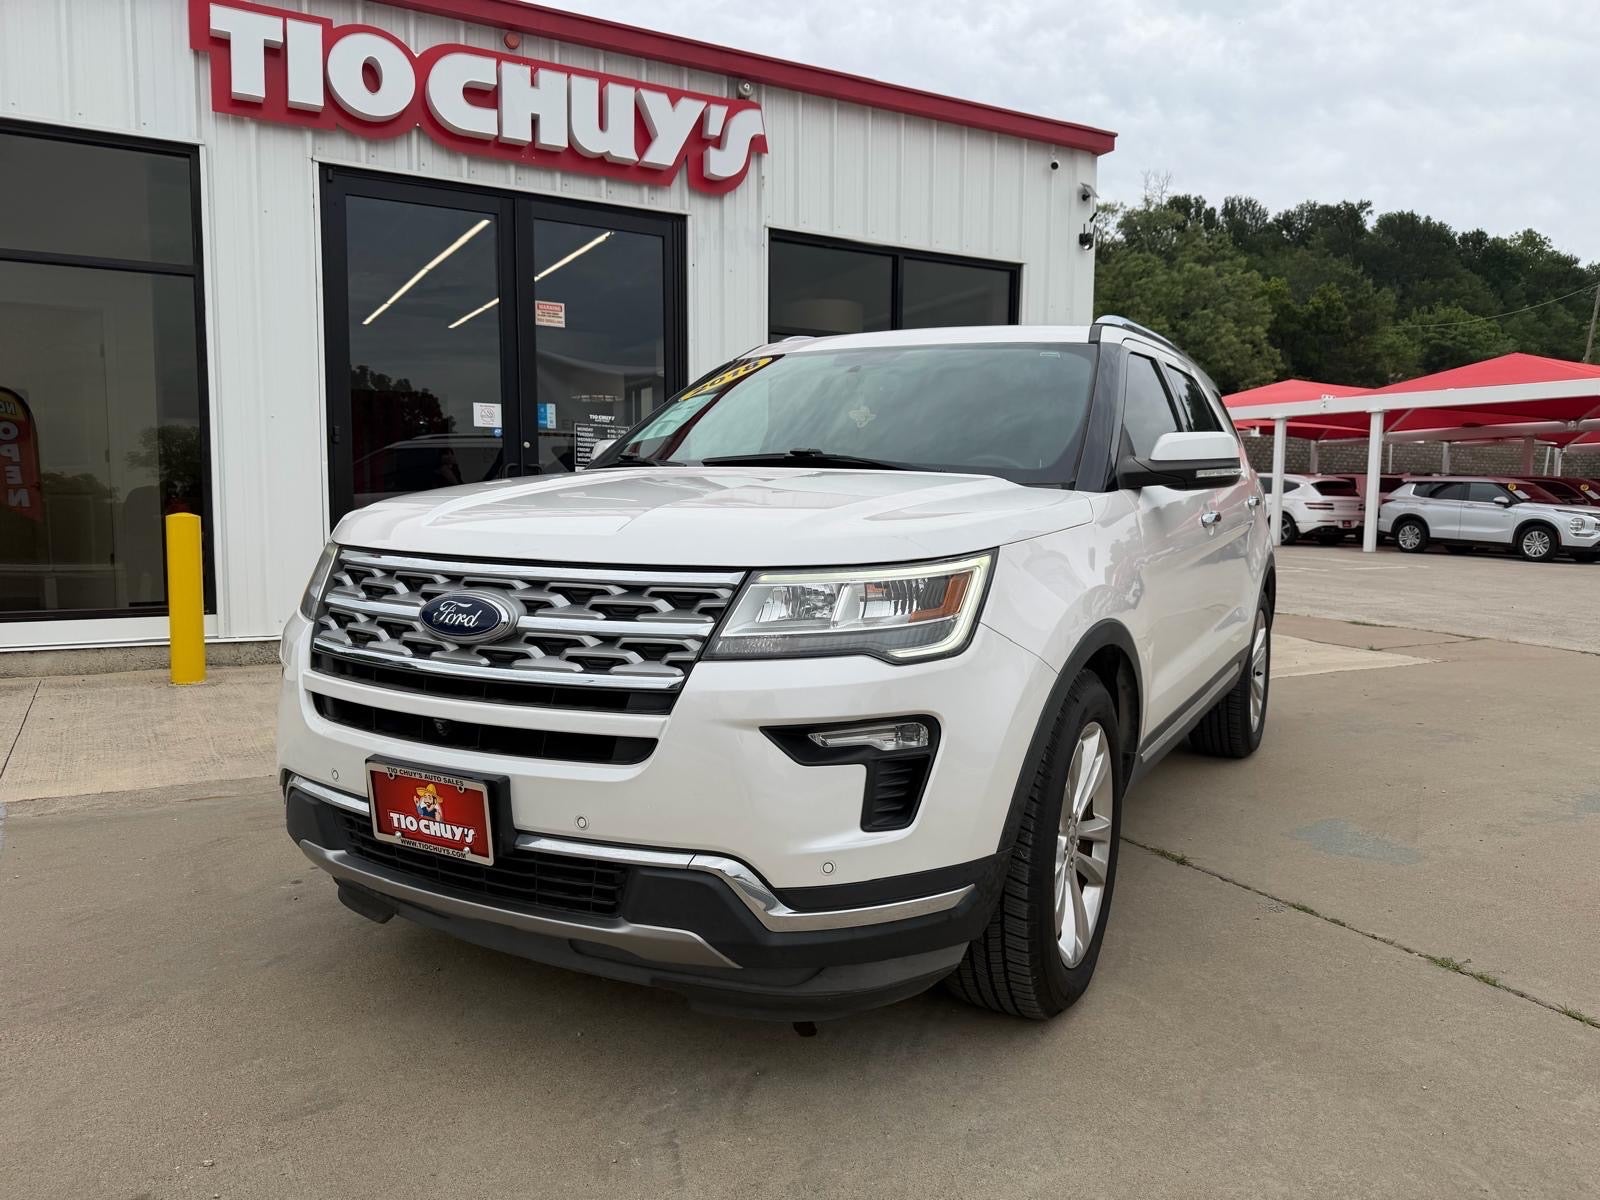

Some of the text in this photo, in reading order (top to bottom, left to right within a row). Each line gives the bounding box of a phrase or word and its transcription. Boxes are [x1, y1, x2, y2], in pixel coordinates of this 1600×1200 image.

[209, 2, 767, 182] TIO CHUY'S
[688, 360, 760, 396] 2018
[433, 600, 483, 628] Ford
[386, 766, 465, 787] TIO CHUY'S AUTO SALES
[389, 812, 476, 844] TIO CHUY'S
[400, 838, 467, 859] WWW.TIOCHUYS.COM
